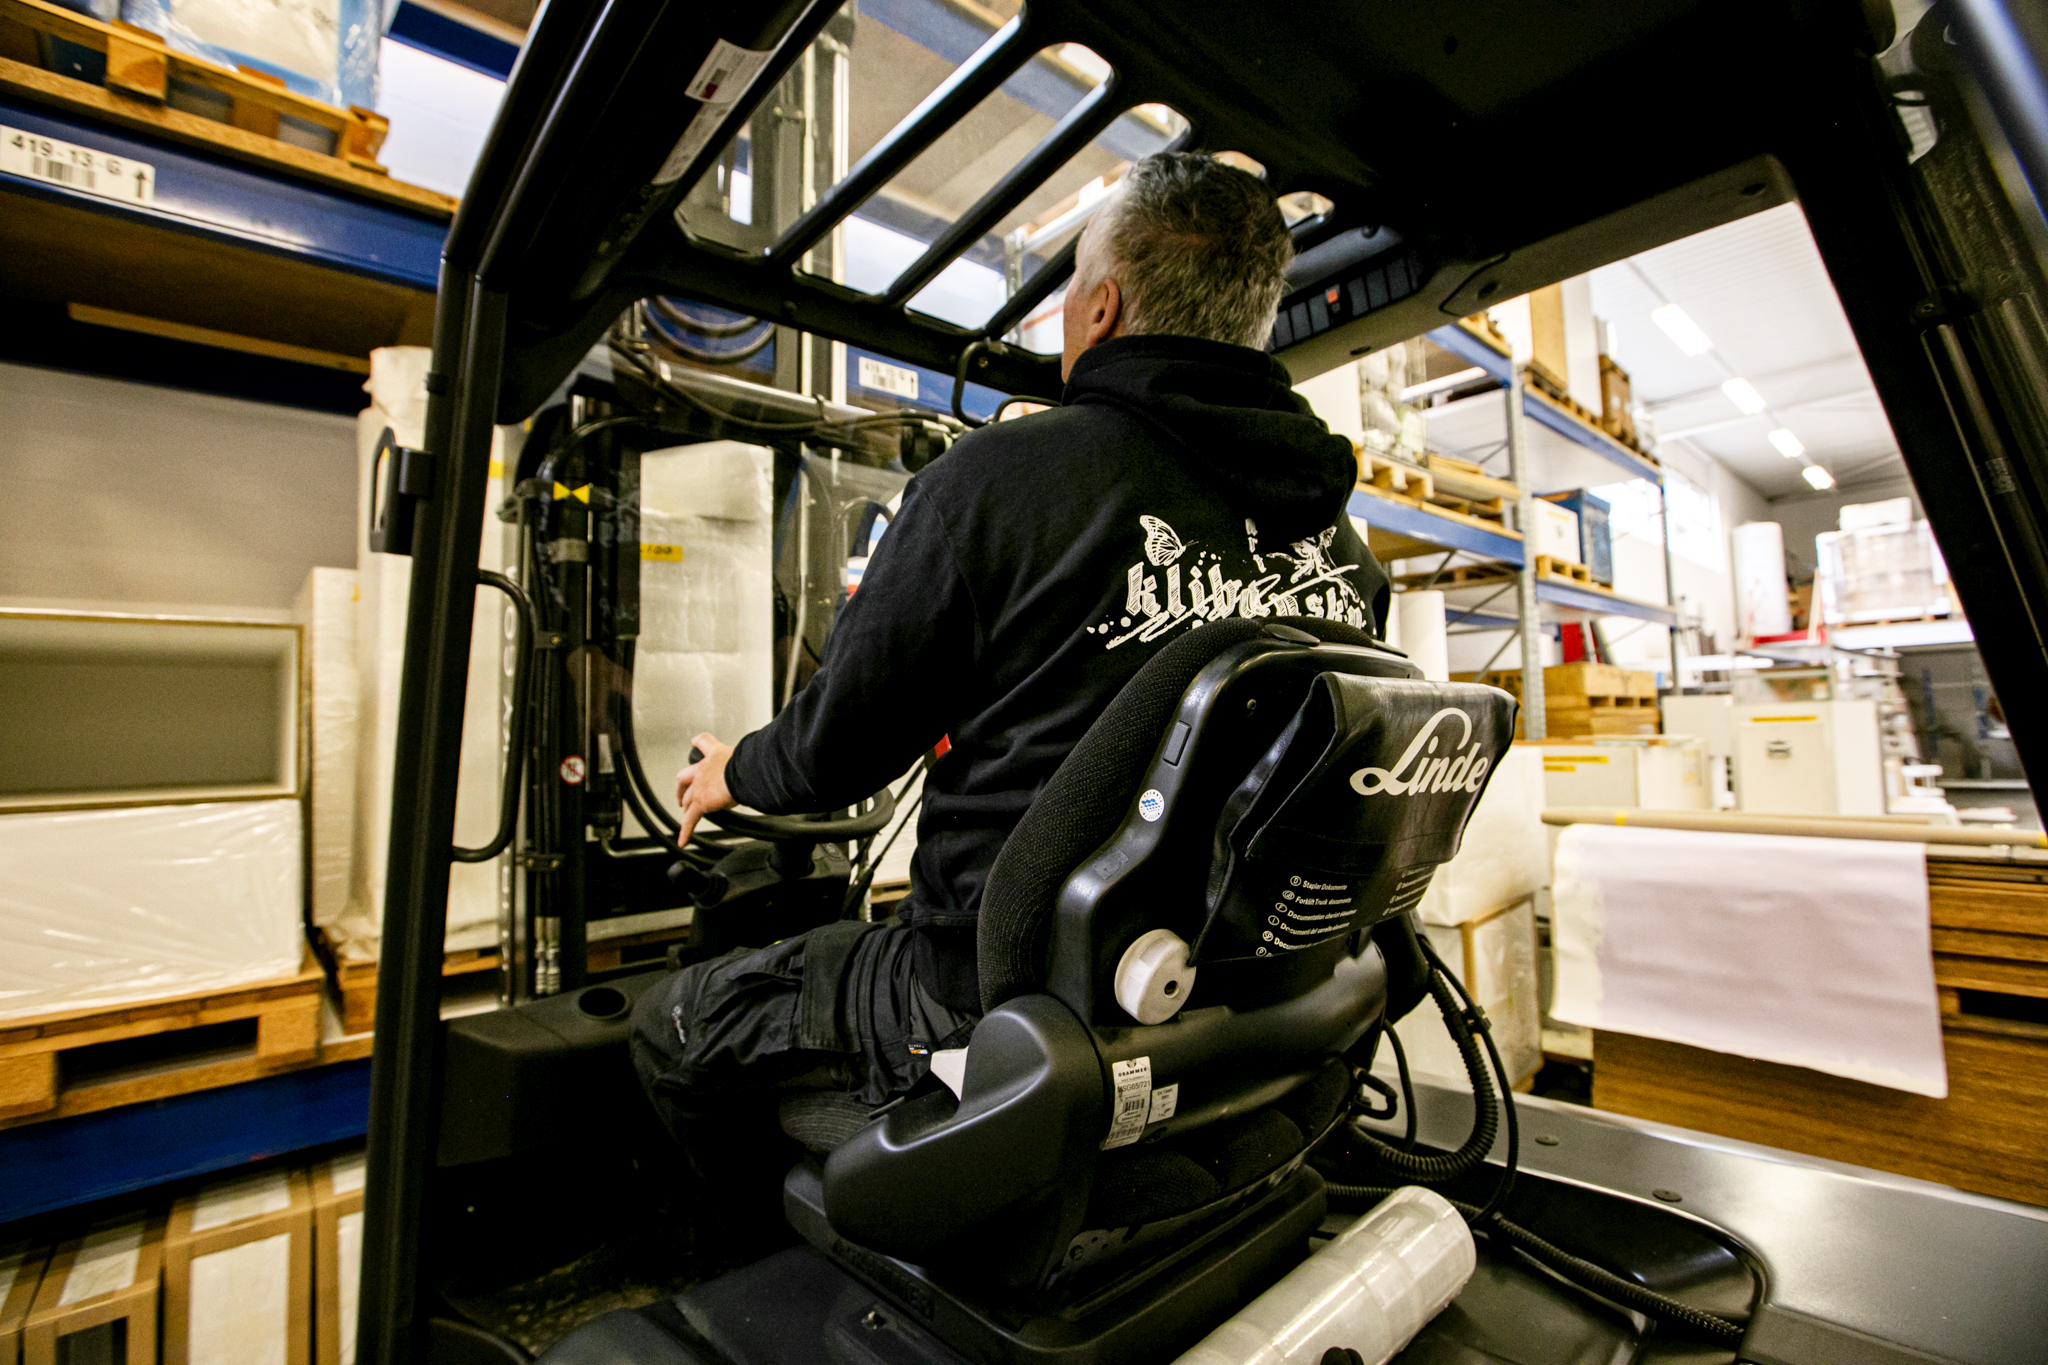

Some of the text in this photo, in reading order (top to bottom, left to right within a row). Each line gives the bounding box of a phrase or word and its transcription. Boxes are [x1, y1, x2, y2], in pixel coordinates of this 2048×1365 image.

[1349, 707, 1489, 796] Linde
[1303, 880, 1321, 890] Stapler
[1295, 896, 1315, 905] Forklift
[1117, 1067, 1148, 1077] GRAMMER
